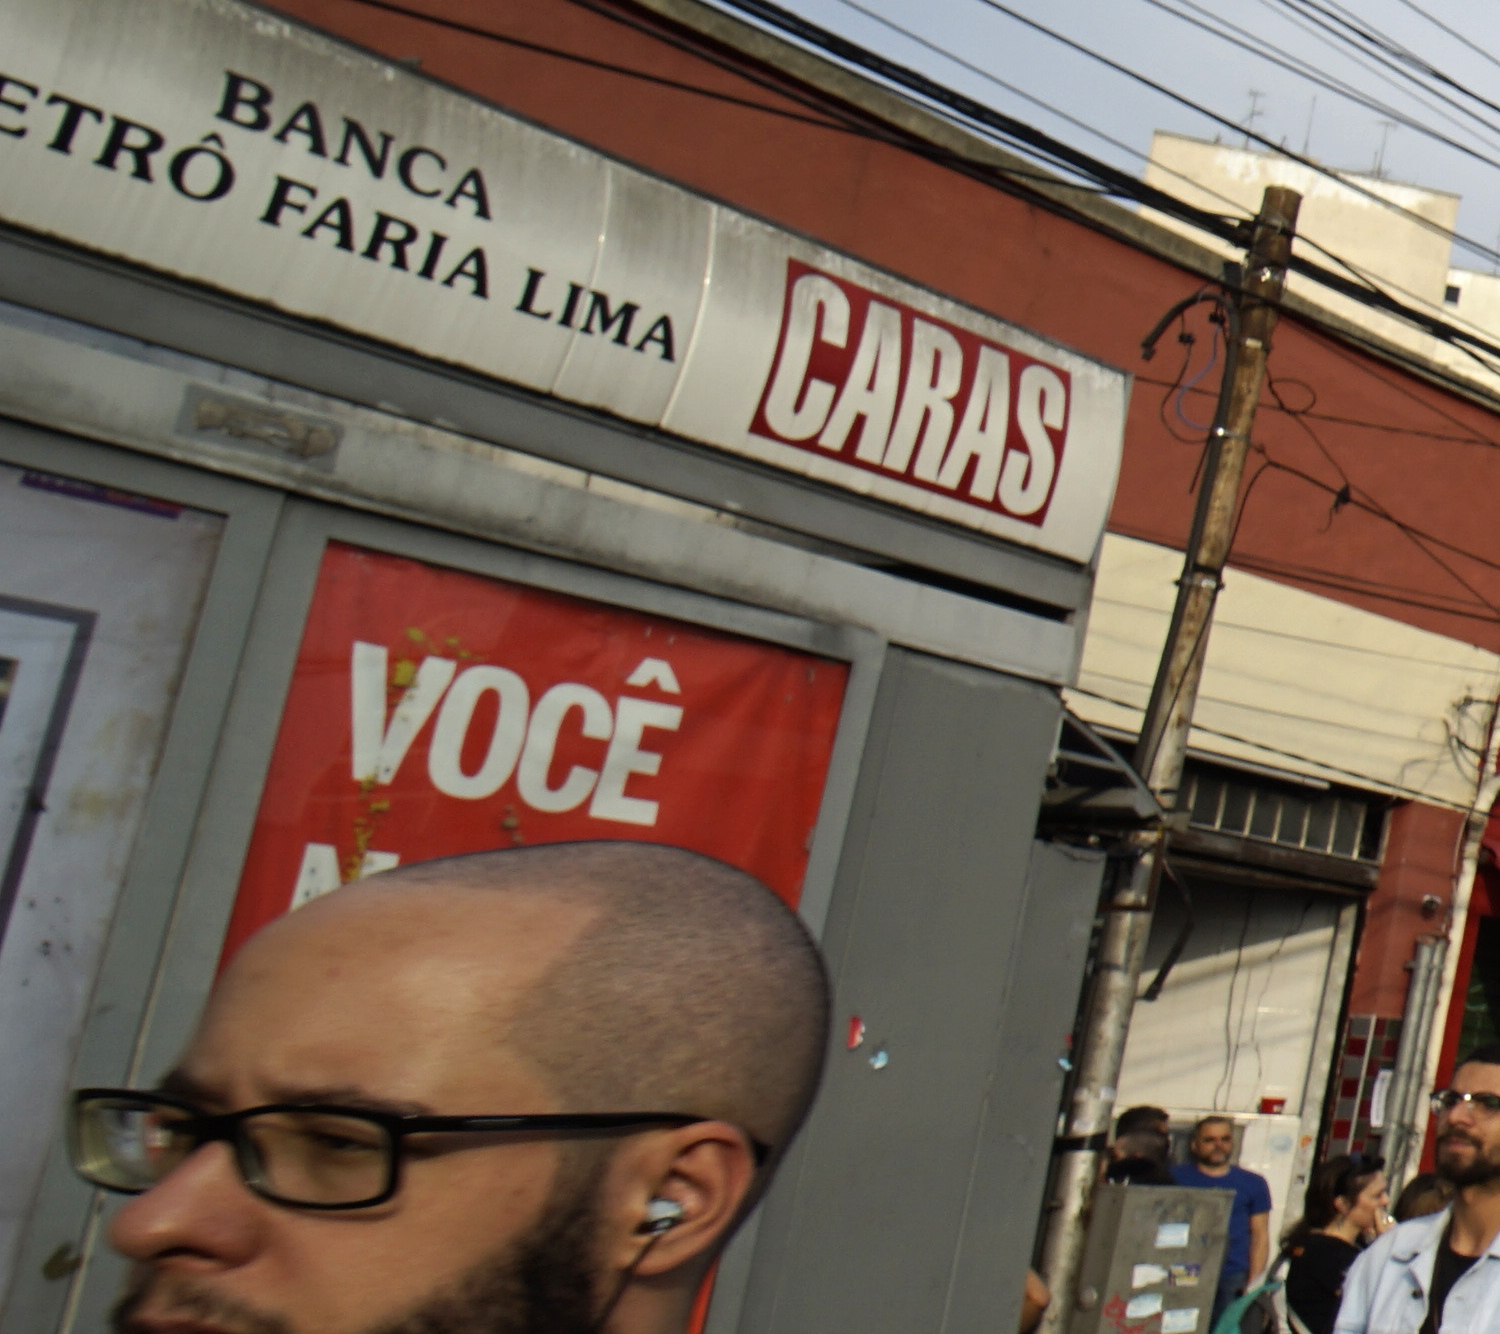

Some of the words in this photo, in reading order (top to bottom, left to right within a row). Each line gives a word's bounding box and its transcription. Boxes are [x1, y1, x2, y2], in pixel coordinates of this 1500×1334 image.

[214, 70, 492, 221] BANCA
[260, 175, 489, 299] FARIA
[515, 267, 676, 362] LIMA
[765, 273, 1066, 516] CARAS
[350, 640, 684, 826] VOCÊ
